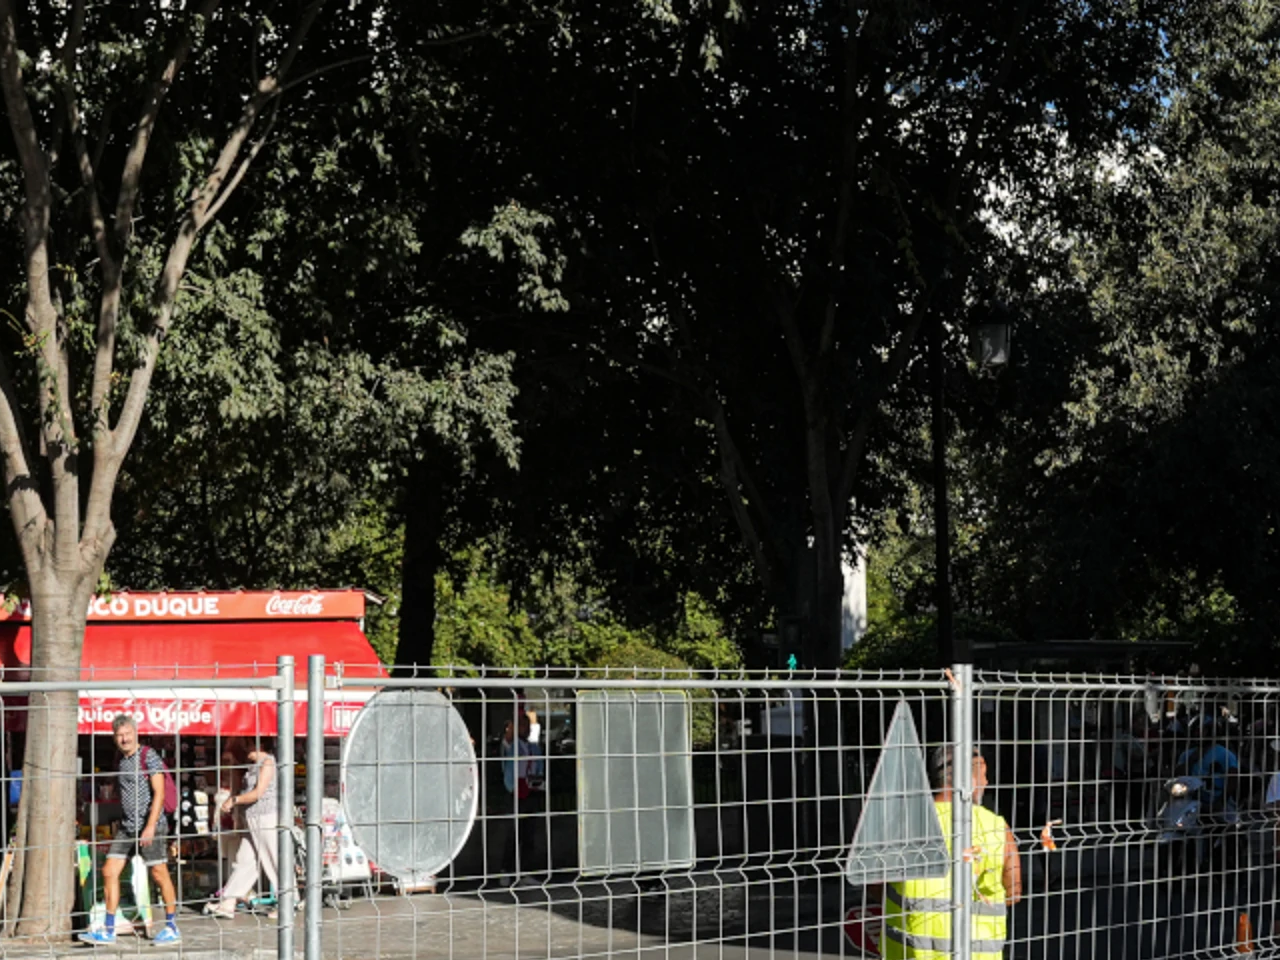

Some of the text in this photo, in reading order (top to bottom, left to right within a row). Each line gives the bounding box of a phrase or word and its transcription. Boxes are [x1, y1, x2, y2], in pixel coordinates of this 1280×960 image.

[134, 597, 219, 617] DUQUE
[265, 594, 325, 616] Coca-Cola
[151, 706, 212, 727] Duque
